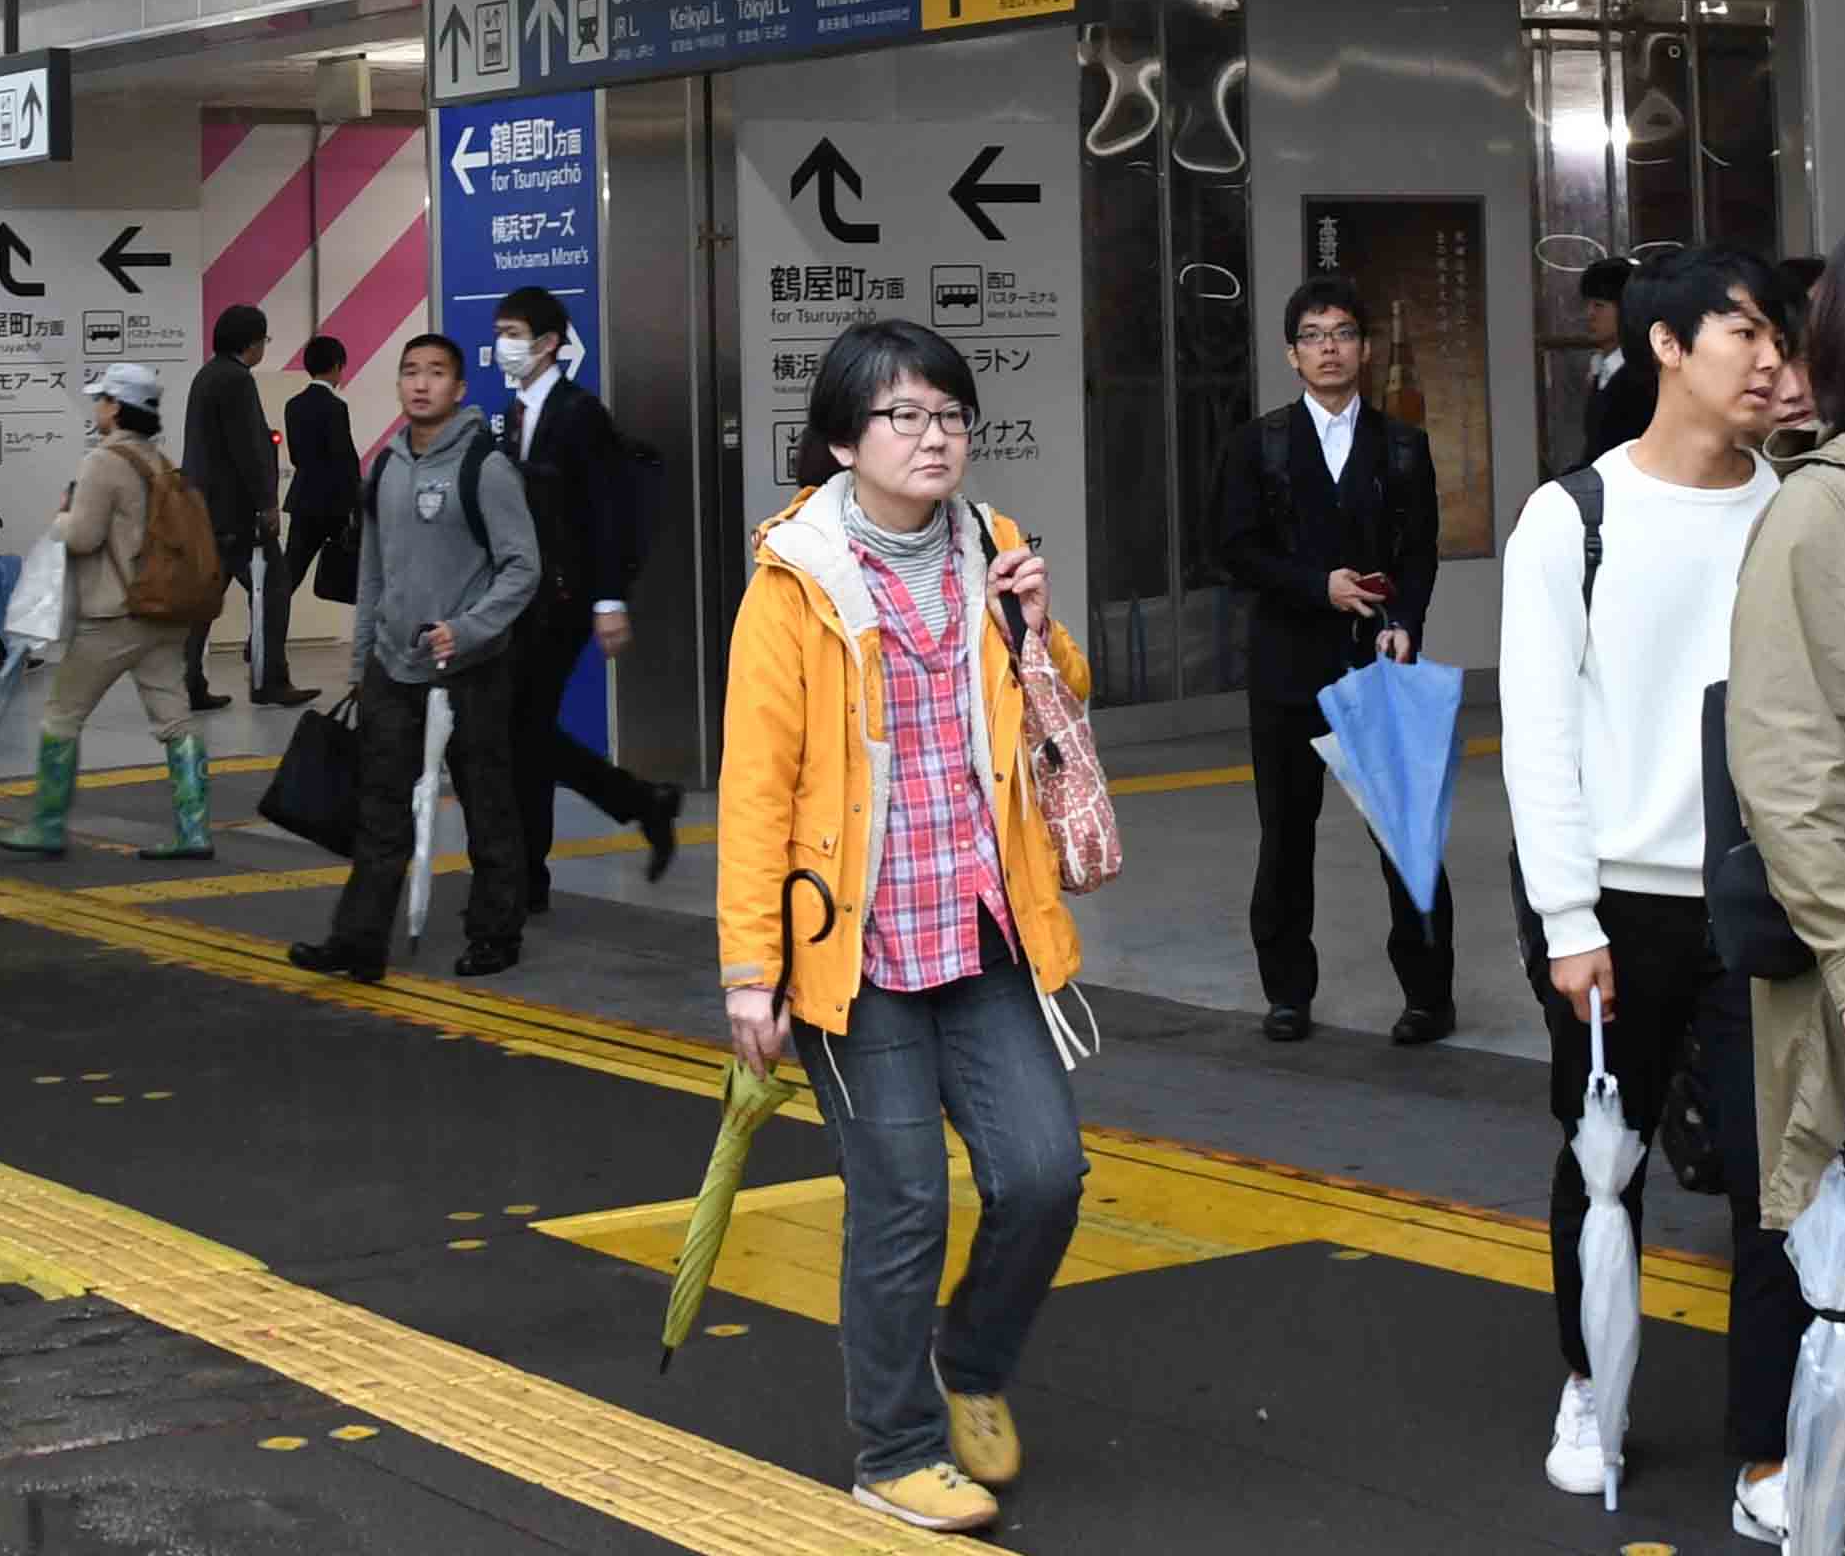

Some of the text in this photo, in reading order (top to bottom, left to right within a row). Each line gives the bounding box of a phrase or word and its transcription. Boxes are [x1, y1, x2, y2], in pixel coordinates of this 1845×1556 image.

[612, 17, 626, 41] JR
[491, 118, 582, 167] 鶴屋町方面
[491, 161, 582, 193] for Tsuruyachō
[492, 209, 576, 245] 横浜モアーズ
[494, 245, 589, 271] Yokohama More's
[770, 265, 1016, 303] 鶴屋町方面 西口
[771, 307, 792, 324] for
